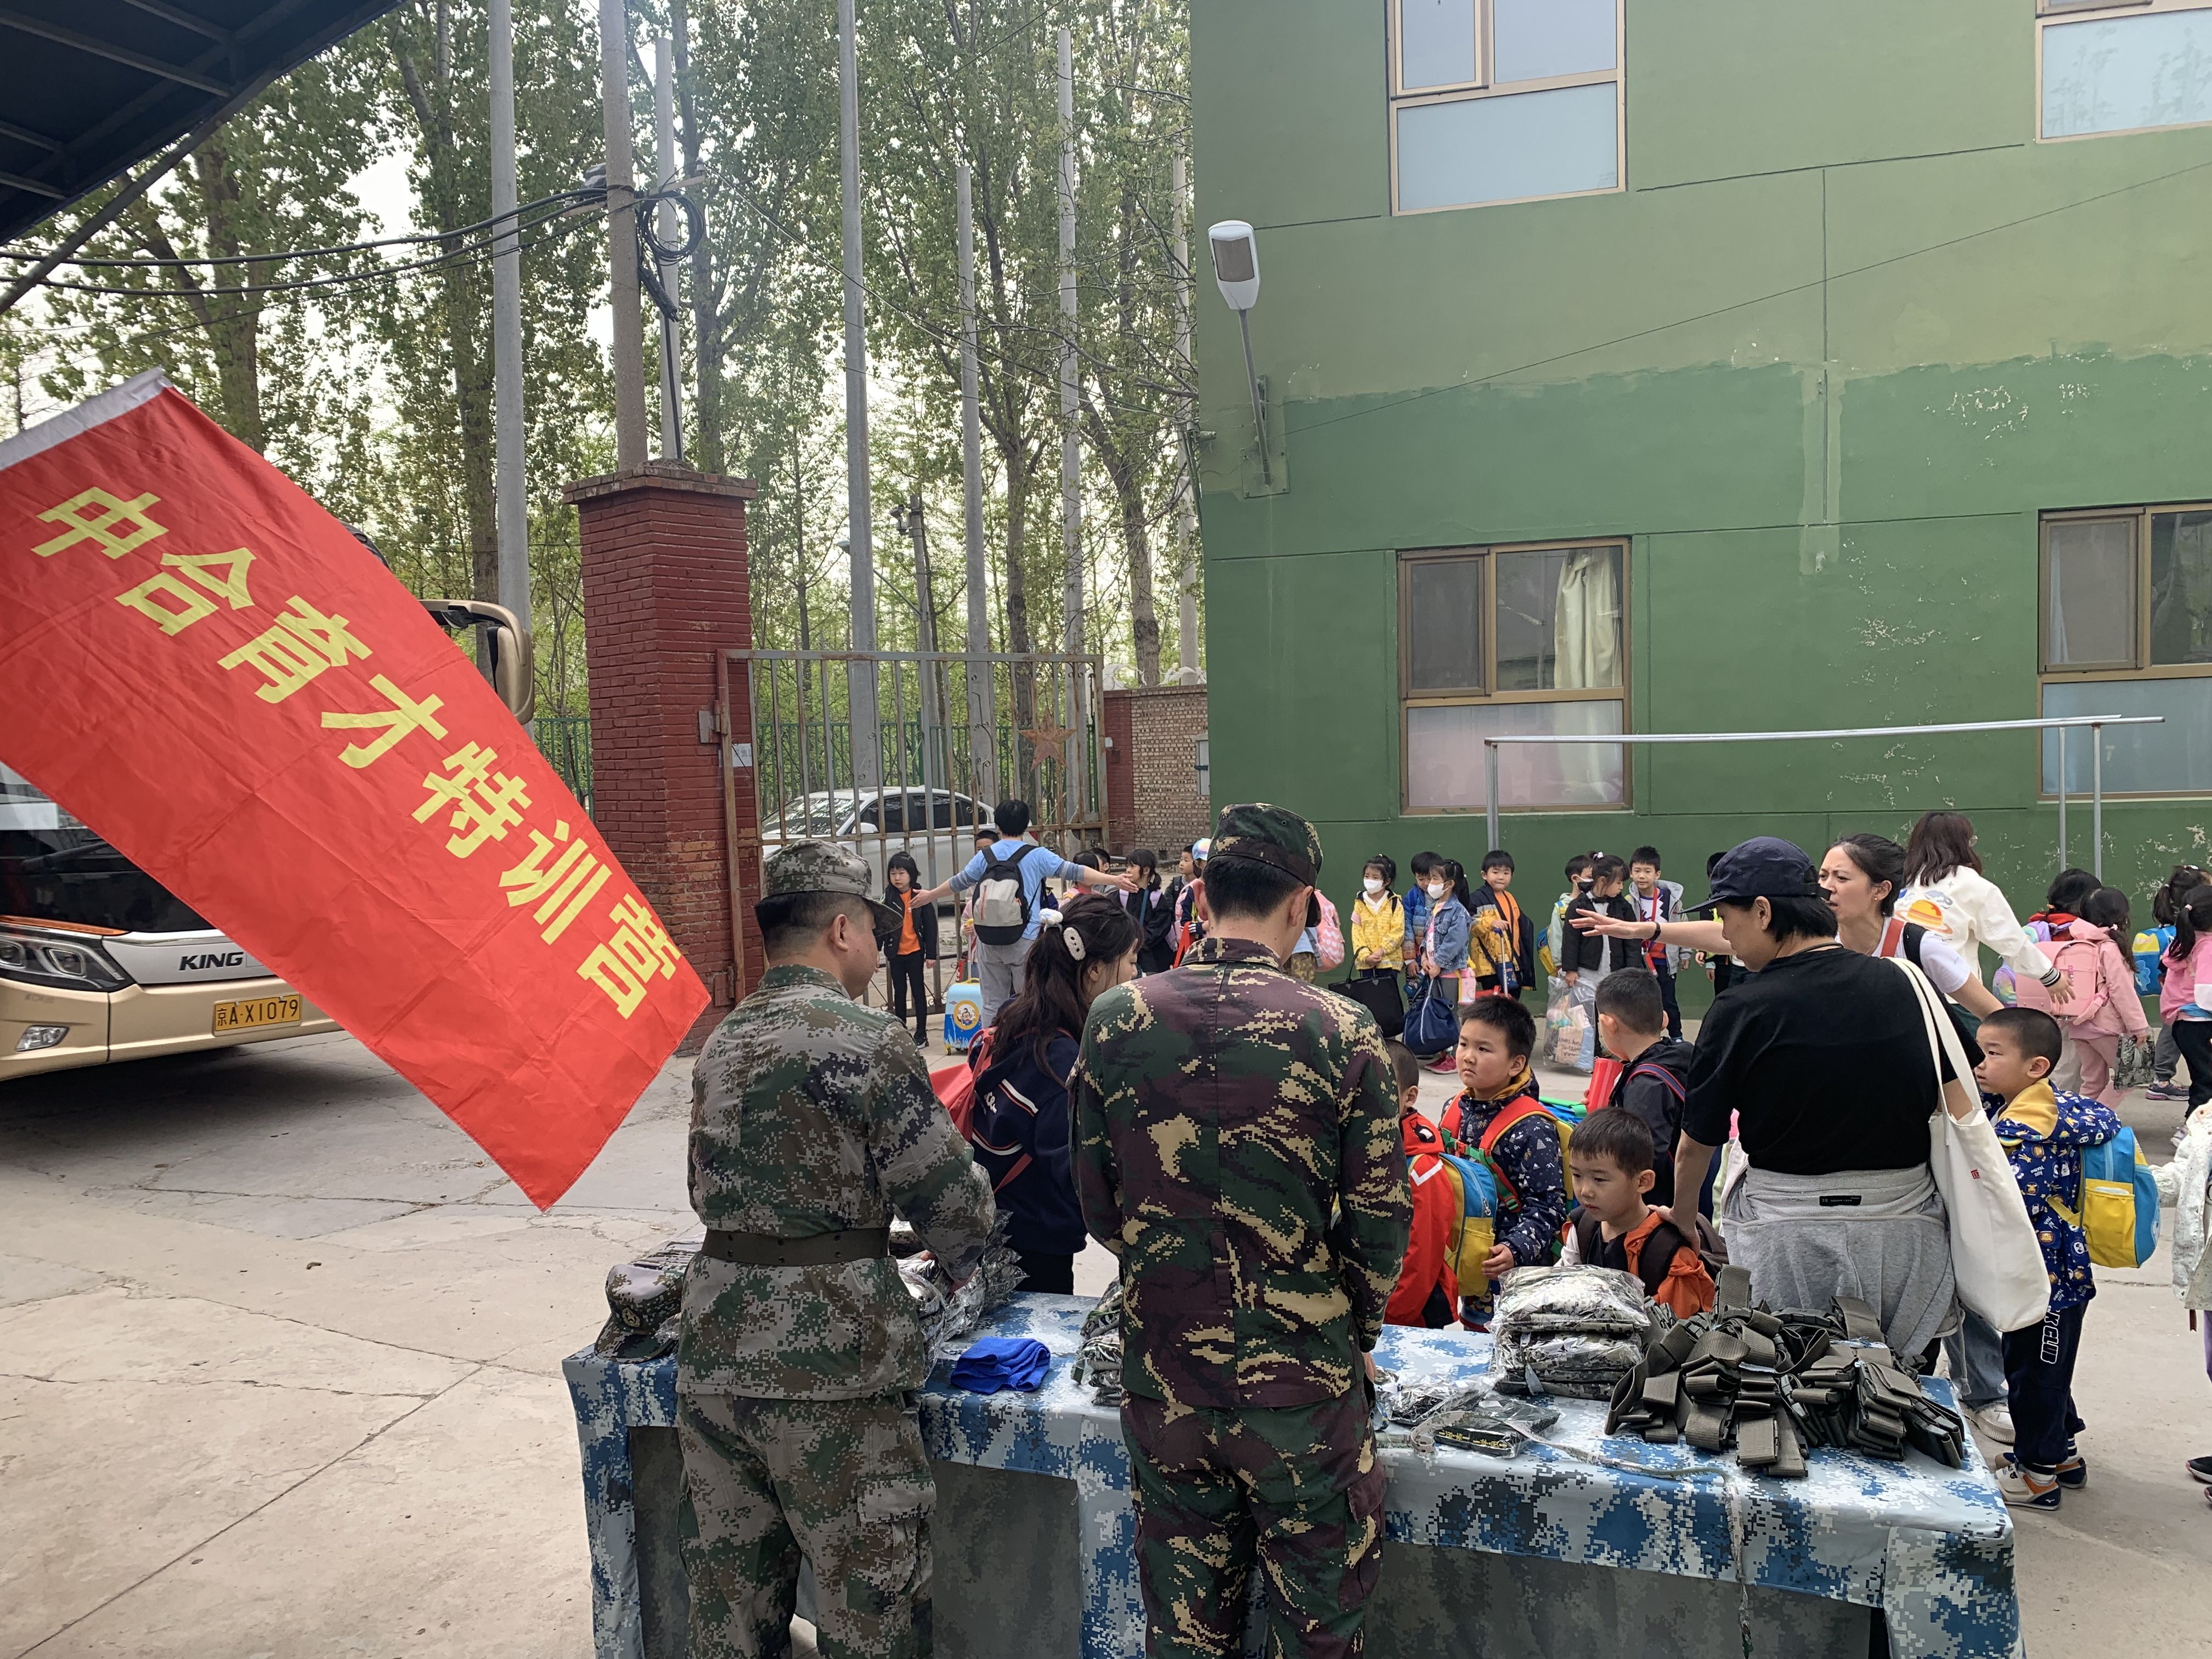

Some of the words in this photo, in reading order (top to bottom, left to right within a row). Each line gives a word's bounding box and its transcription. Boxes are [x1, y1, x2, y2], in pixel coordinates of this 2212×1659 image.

[31, 486, 680, 1019] 中合育才特训营
[179, 952, 244, 971] KING
